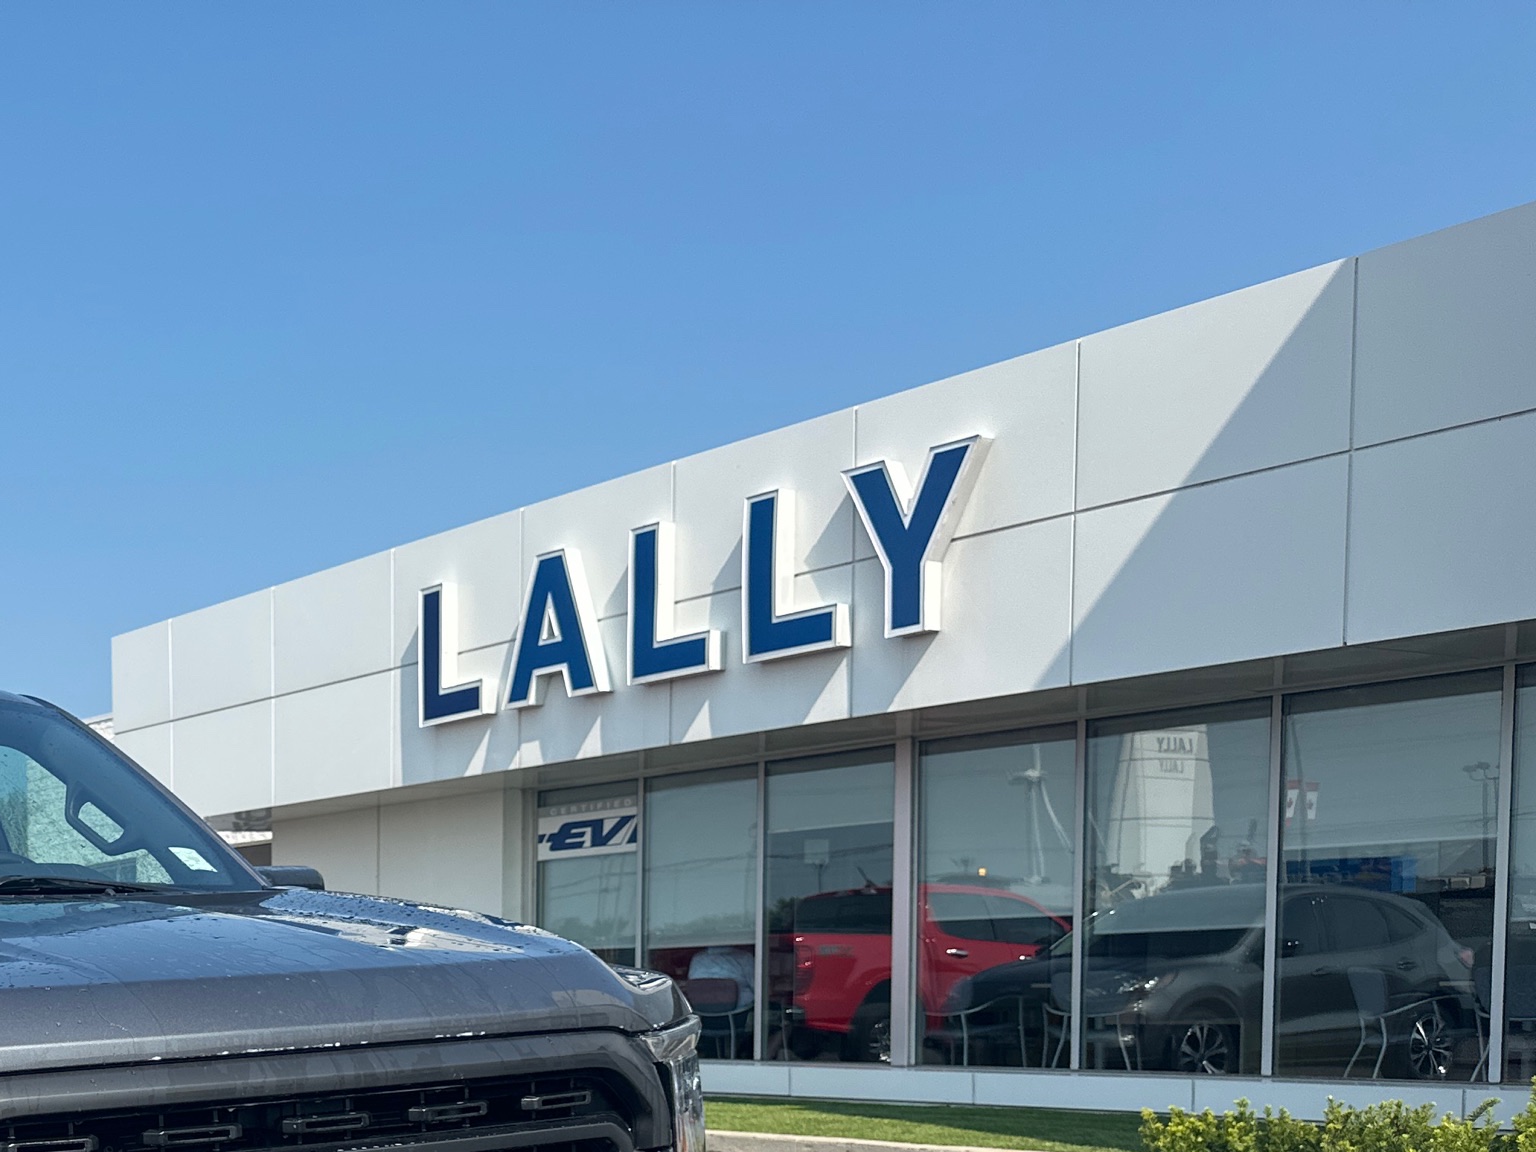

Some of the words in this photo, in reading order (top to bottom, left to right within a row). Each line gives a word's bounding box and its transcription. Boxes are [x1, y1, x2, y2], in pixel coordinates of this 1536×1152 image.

[418, 434, 988, 728] LALLY
[549, 799, 632, 816] CERTIFIED
[548, 815, 637, 851] EV
